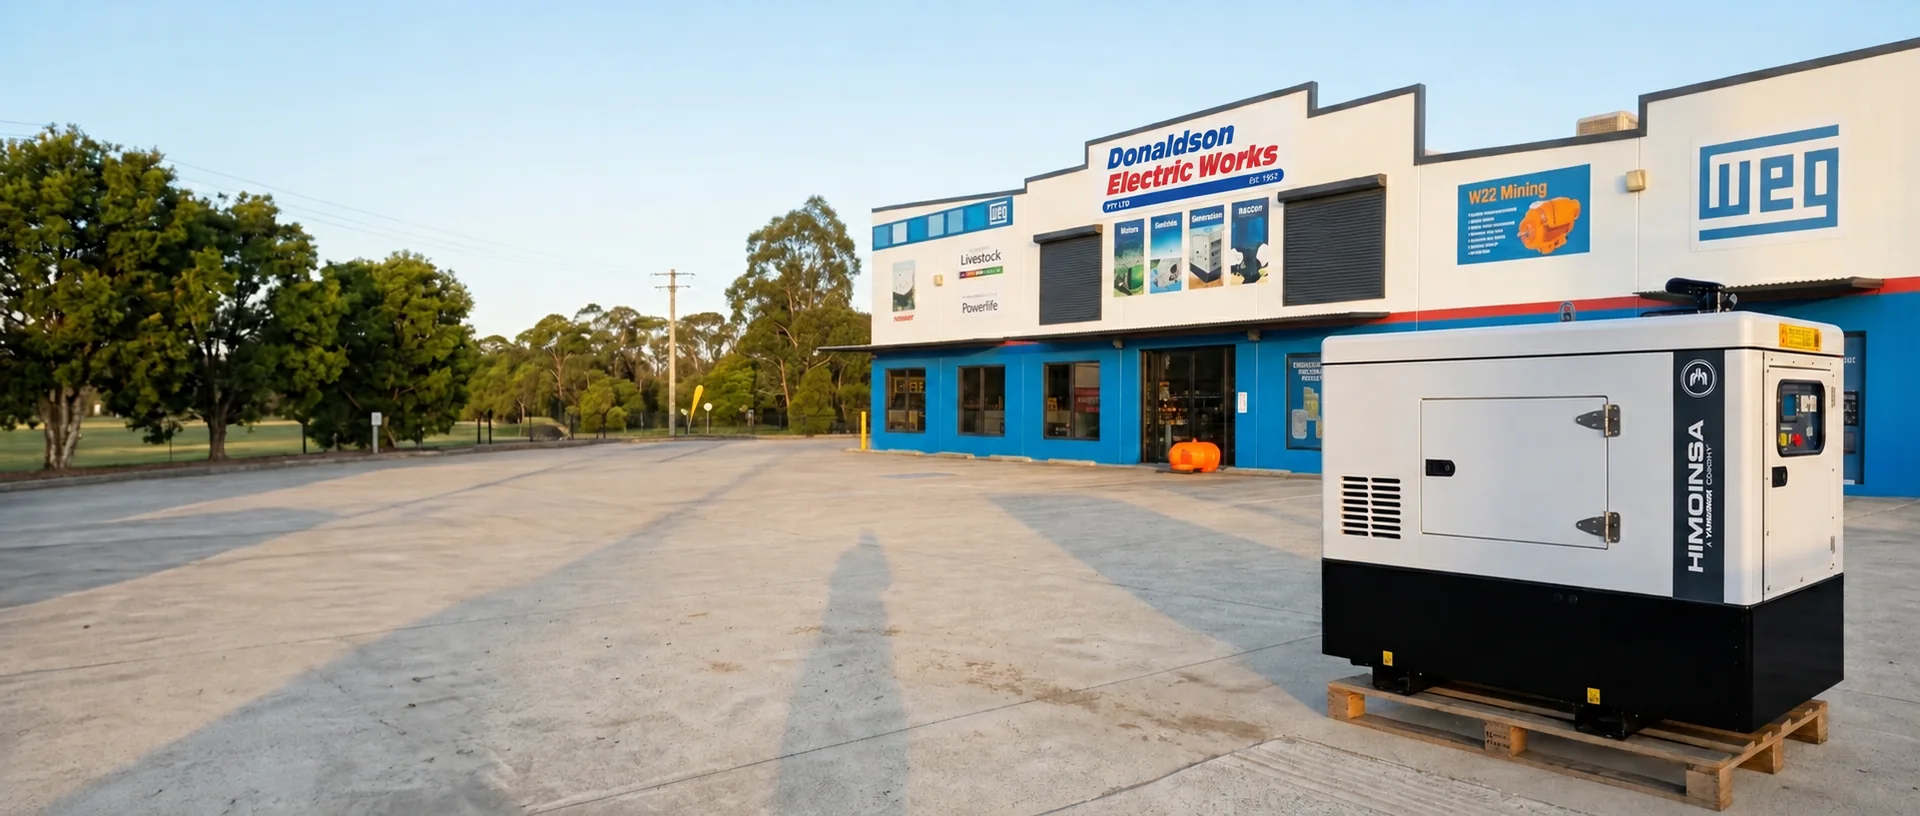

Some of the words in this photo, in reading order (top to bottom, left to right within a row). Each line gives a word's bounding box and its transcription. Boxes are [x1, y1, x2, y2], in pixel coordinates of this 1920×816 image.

[1107, 124, 1234, 170] Donaldson
[1106, 159, 1194, 196] Electric
[1199, 144, 1278, 178] Works
[1468, 187, 1497, 205] W22
[1501, 182, 1547, 198] Mining
[1106, 202, 1117, 210] PTY
[1191, 211, 1223, 222] Generation
[960, 249, 1002, 265] Livestock
[962, 300, 998, 313] Powerlife
[1688, 419, 1704, 573] HIMOINSA
